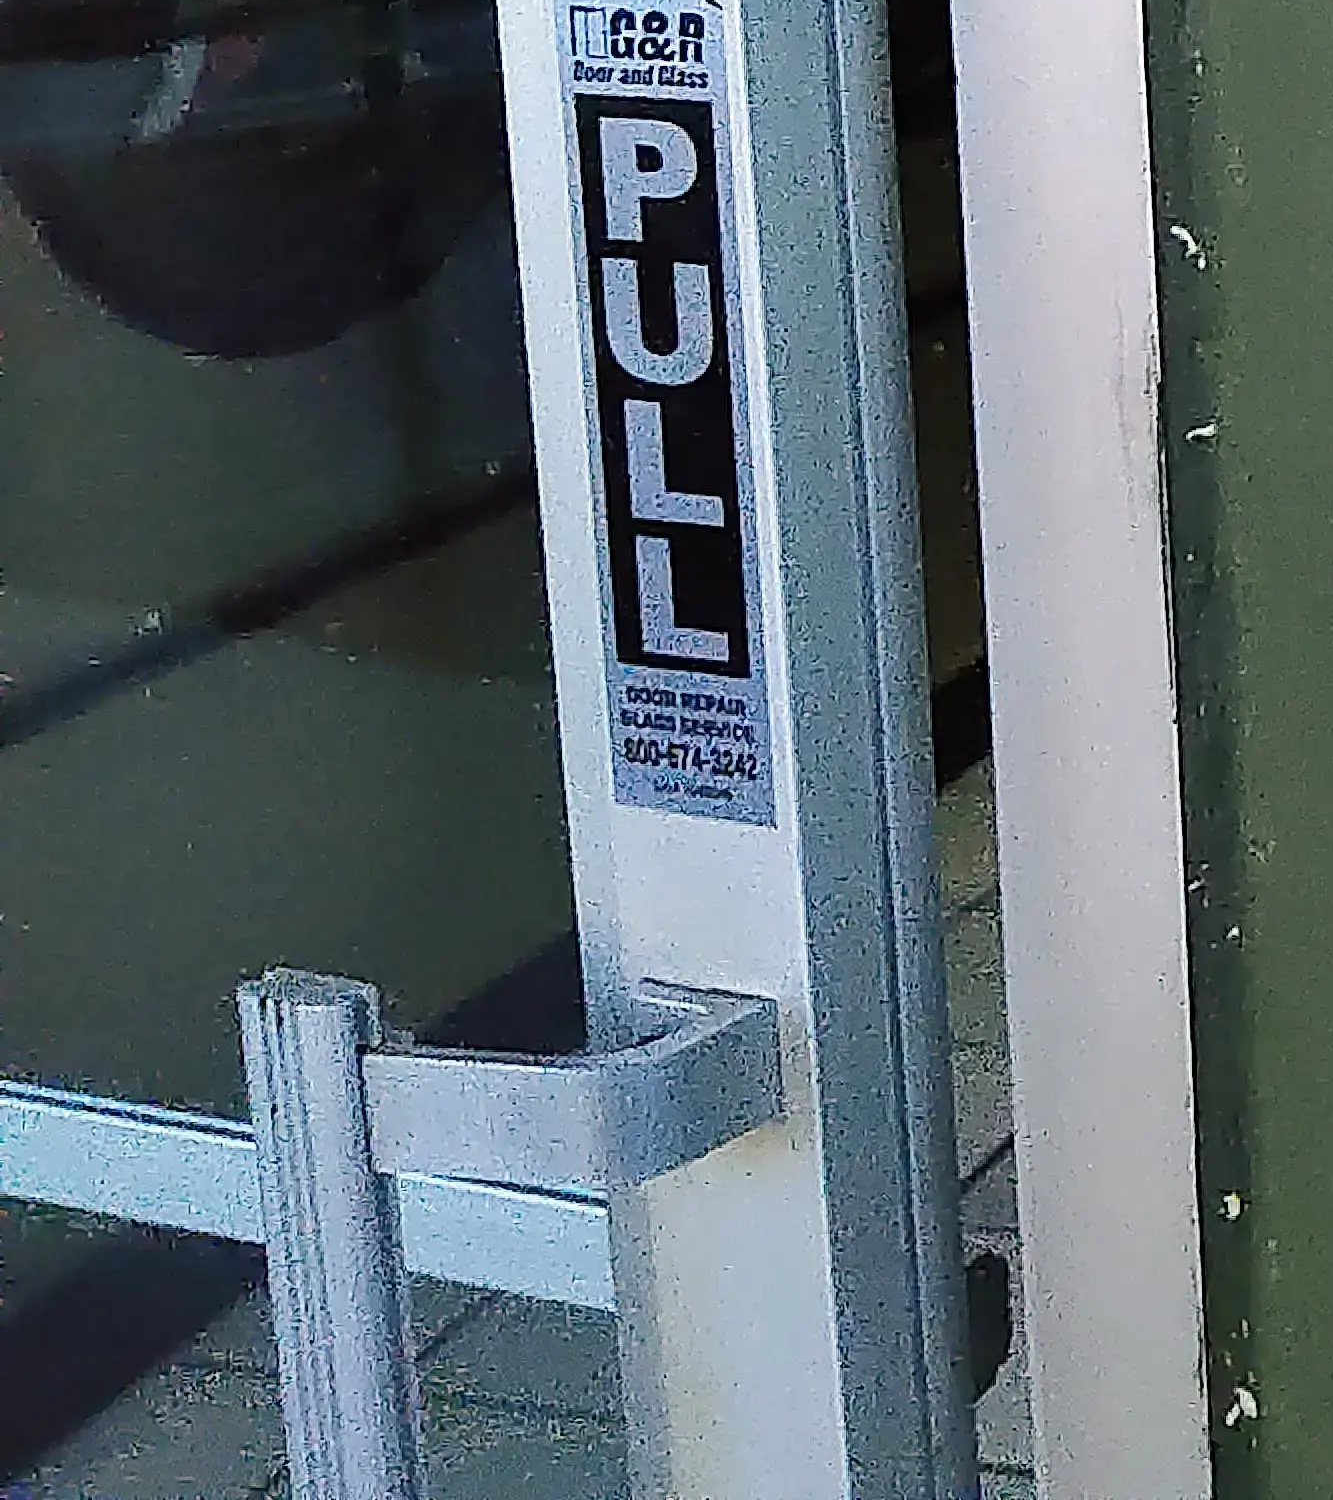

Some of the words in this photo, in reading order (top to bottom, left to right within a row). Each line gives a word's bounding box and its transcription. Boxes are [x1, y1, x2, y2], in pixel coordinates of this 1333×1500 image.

[573, 60, 613, 83] Door
[617, 66, 654, 87] and
[657, 66, 709, 88] Glass
[600, 117, 730, 662] PULL
[626, 685, 676, 707] DOOR
[680, 693, 747, 718] REPAIR
